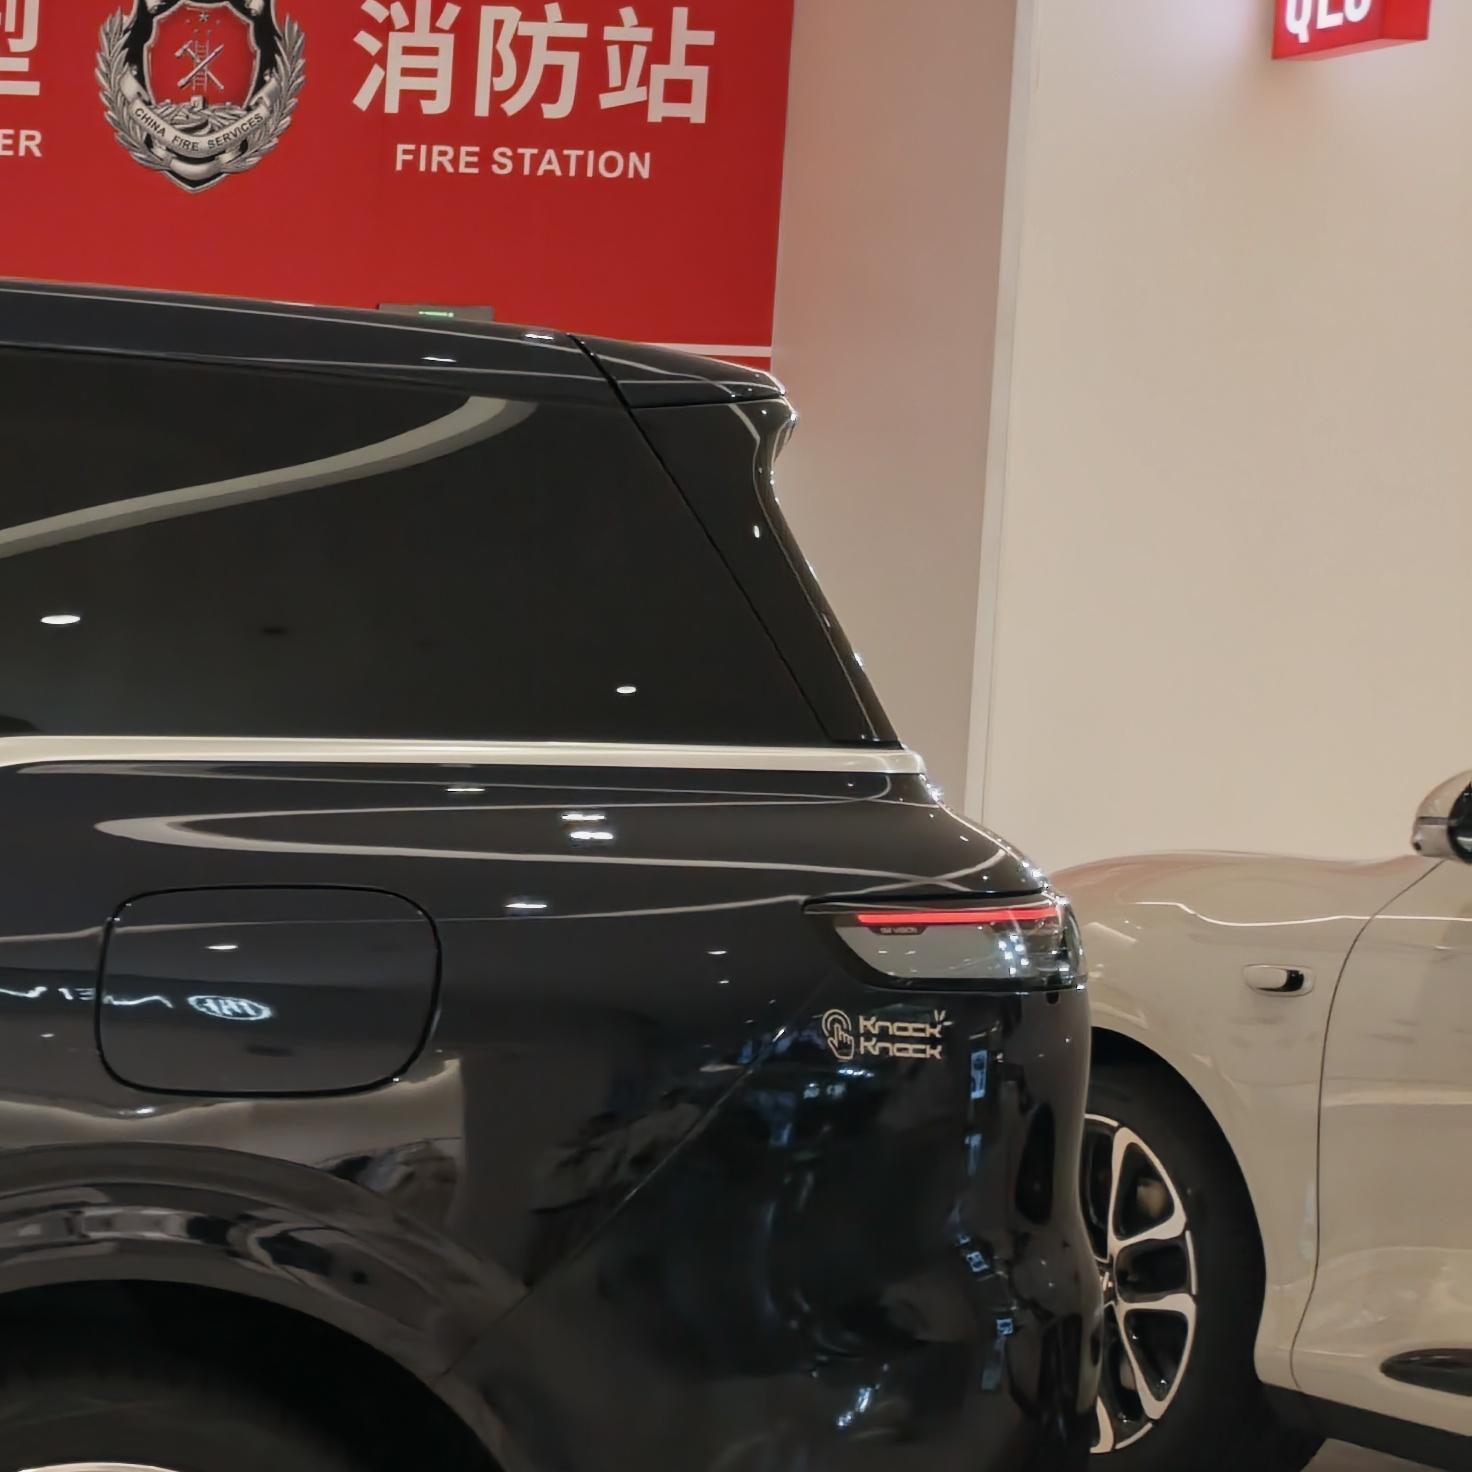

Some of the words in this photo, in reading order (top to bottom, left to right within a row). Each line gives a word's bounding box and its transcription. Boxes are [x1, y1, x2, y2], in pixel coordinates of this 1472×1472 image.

[135, 108, 166, 137] CHINA
[172, 135, 199, 152] FIRE
[208, 113, 264, 150] SERVICES
[395, 144, 480, 174] FIRE
[491, 146, 652, 179] STATION
